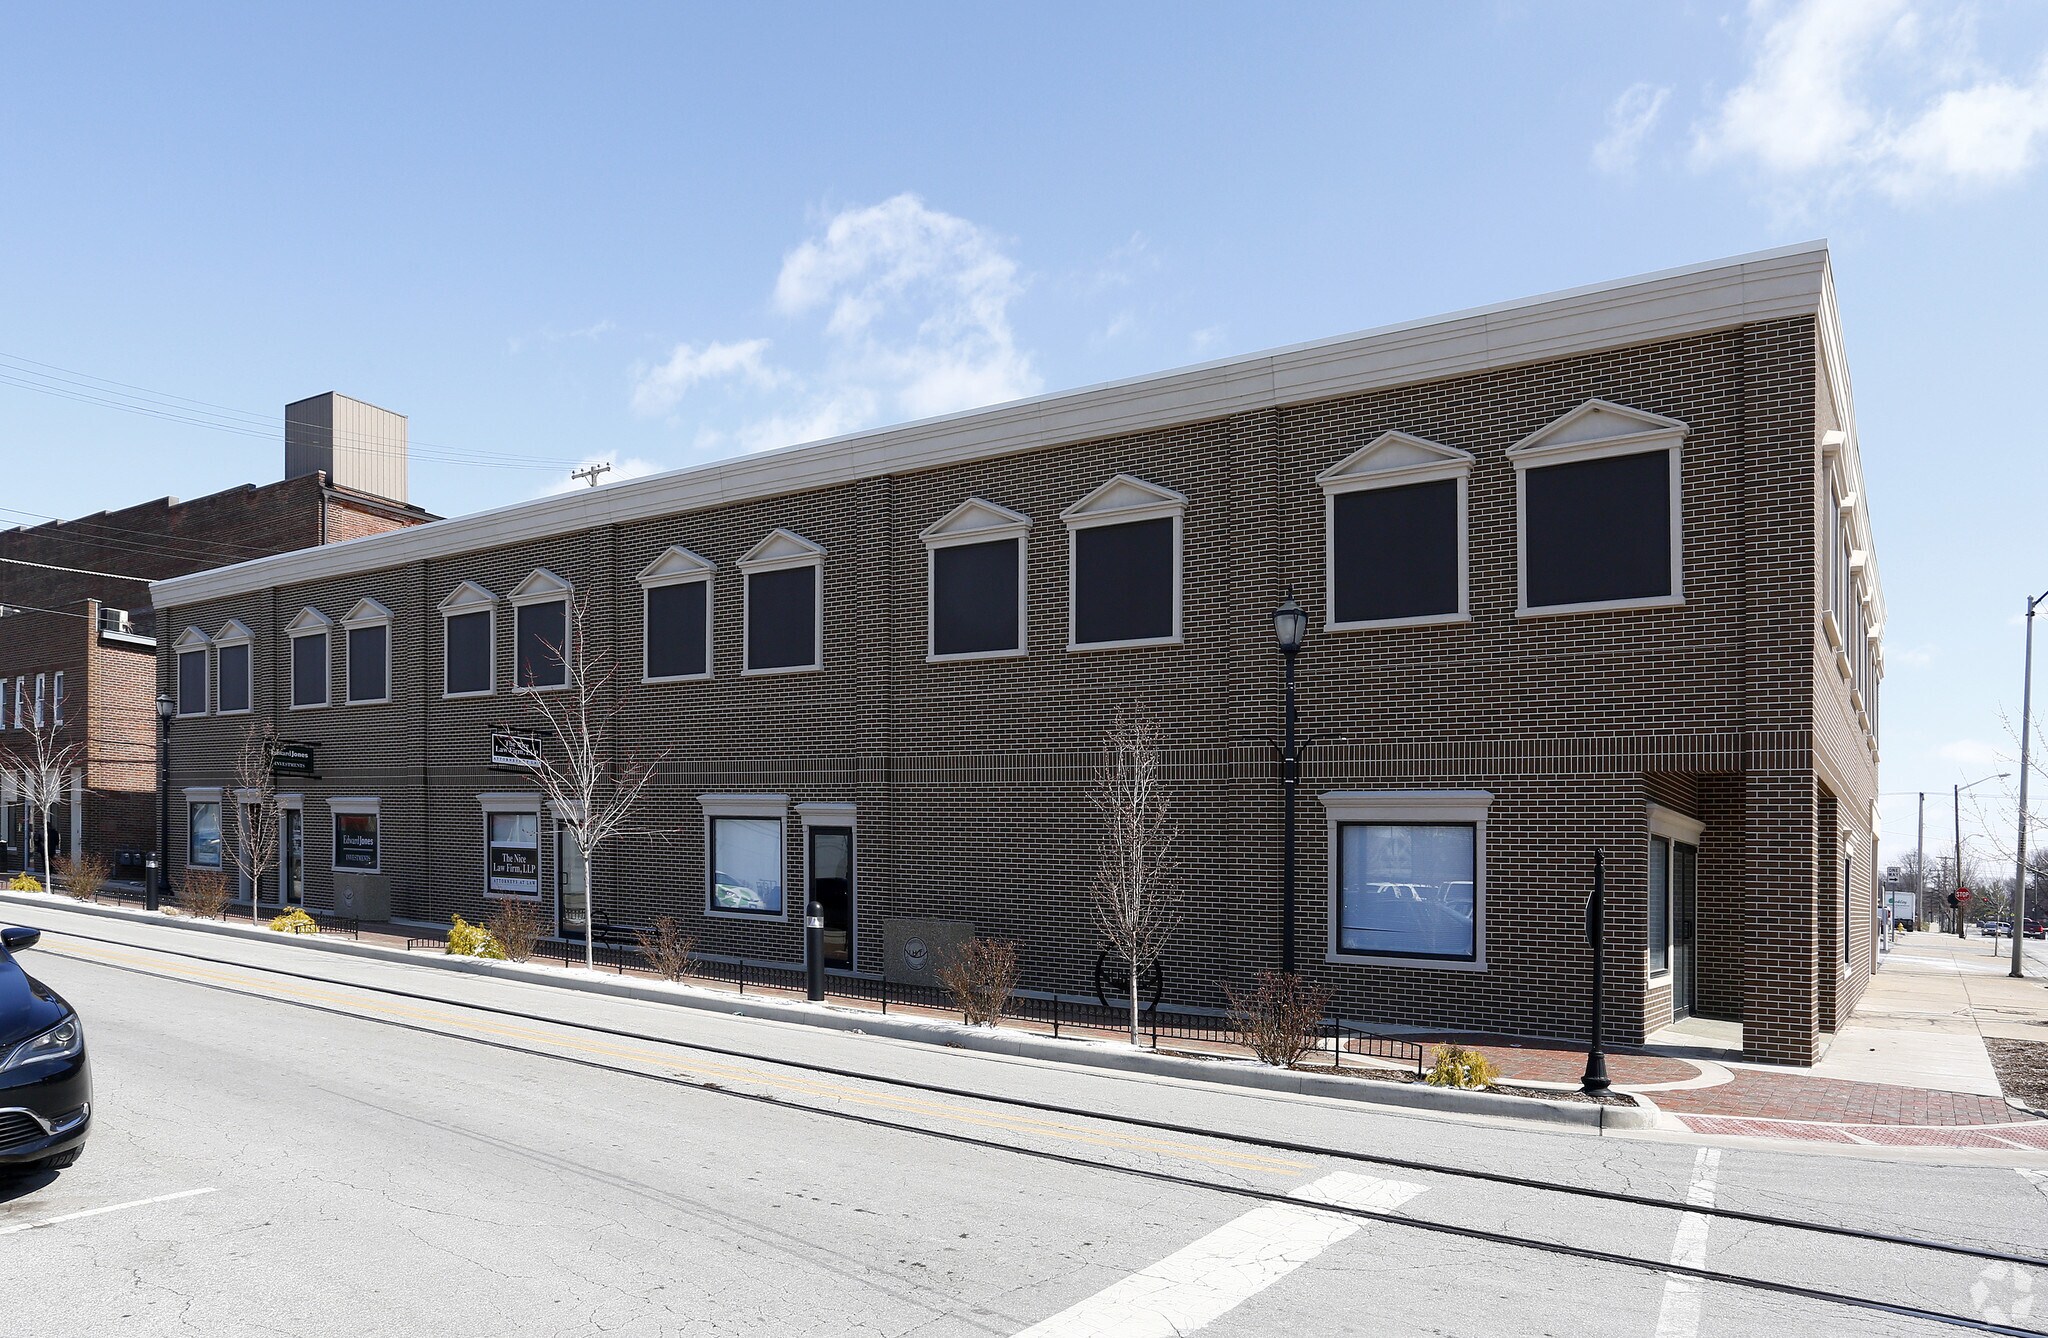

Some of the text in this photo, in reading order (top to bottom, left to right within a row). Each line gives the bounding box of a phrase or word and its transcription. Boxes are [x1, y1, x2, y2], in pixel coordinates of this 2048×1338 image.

[502, 853, 527, 864] The Nice
[493, 862, 506, 872] Law
[523, 864, 536, 874] LLP
